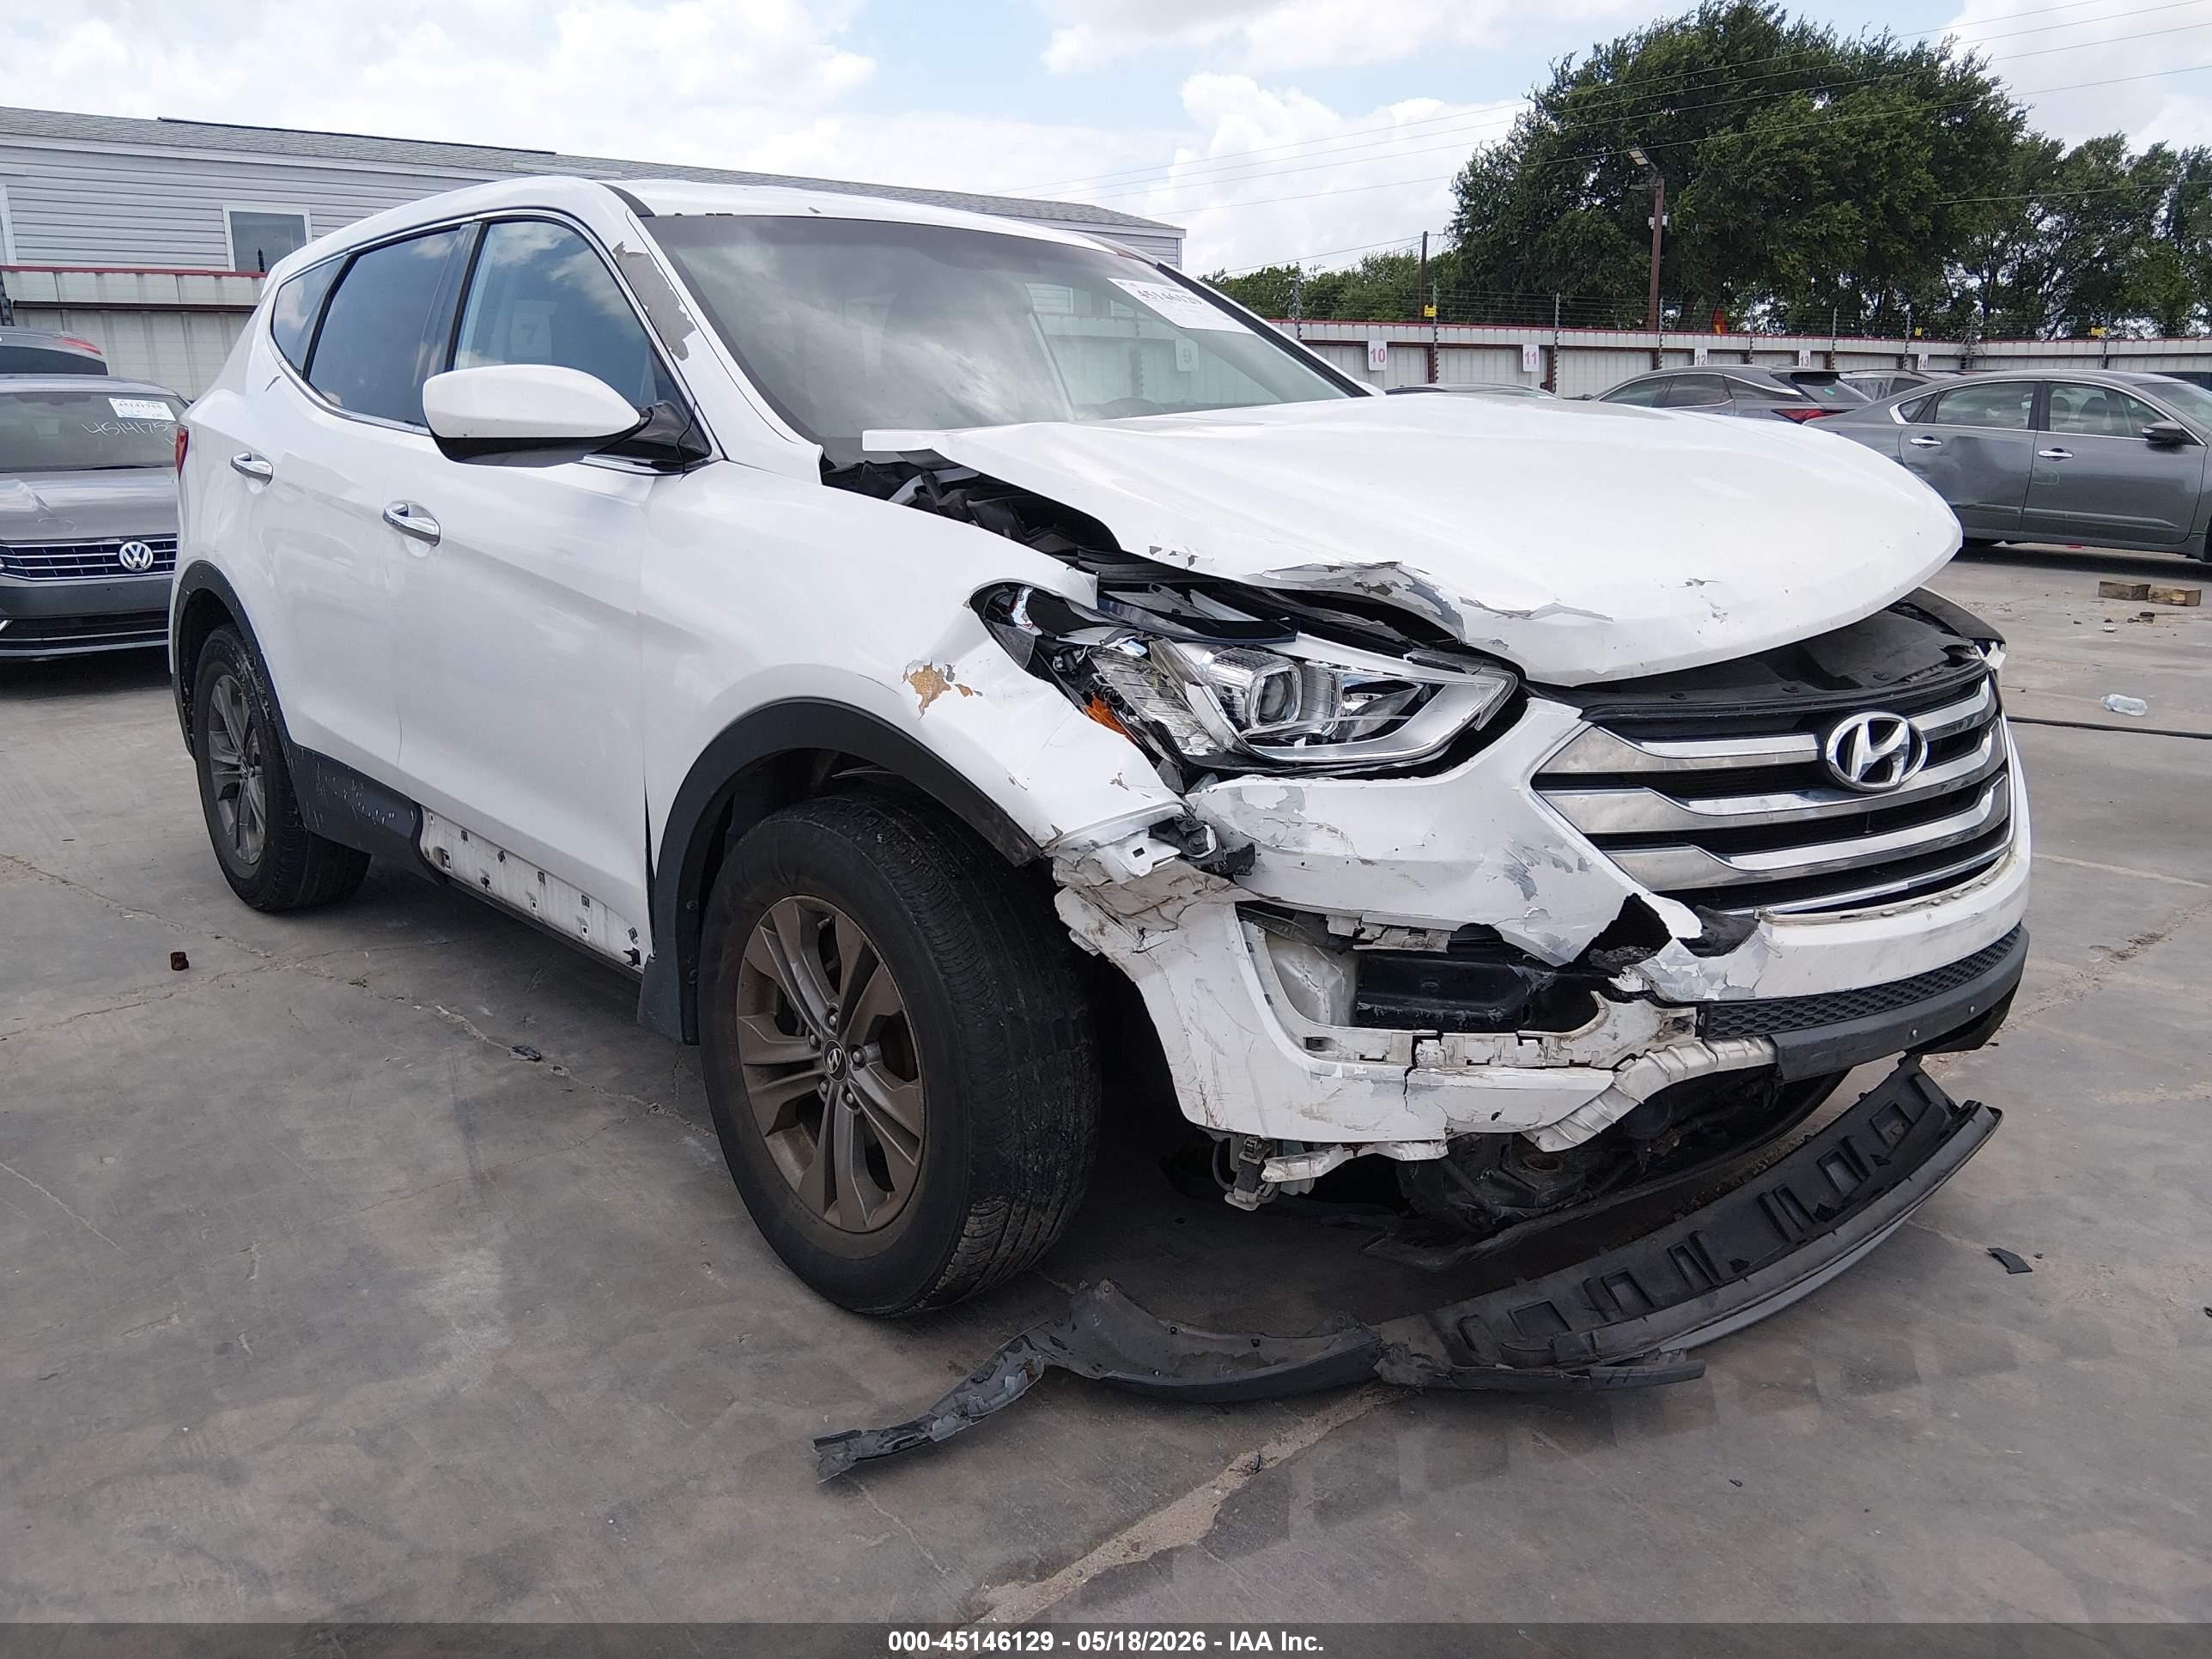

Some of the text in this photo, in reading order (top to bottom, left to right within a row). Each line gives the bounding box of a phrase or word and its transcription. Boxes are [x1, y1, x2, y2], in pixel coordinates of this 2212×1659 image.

[1370, 348, 1386, 363] 10
[1524, 351, 1538, 365] 11
[1696, 355, 1706, 366] 12
[1800, 356, 1809, 368] 13
